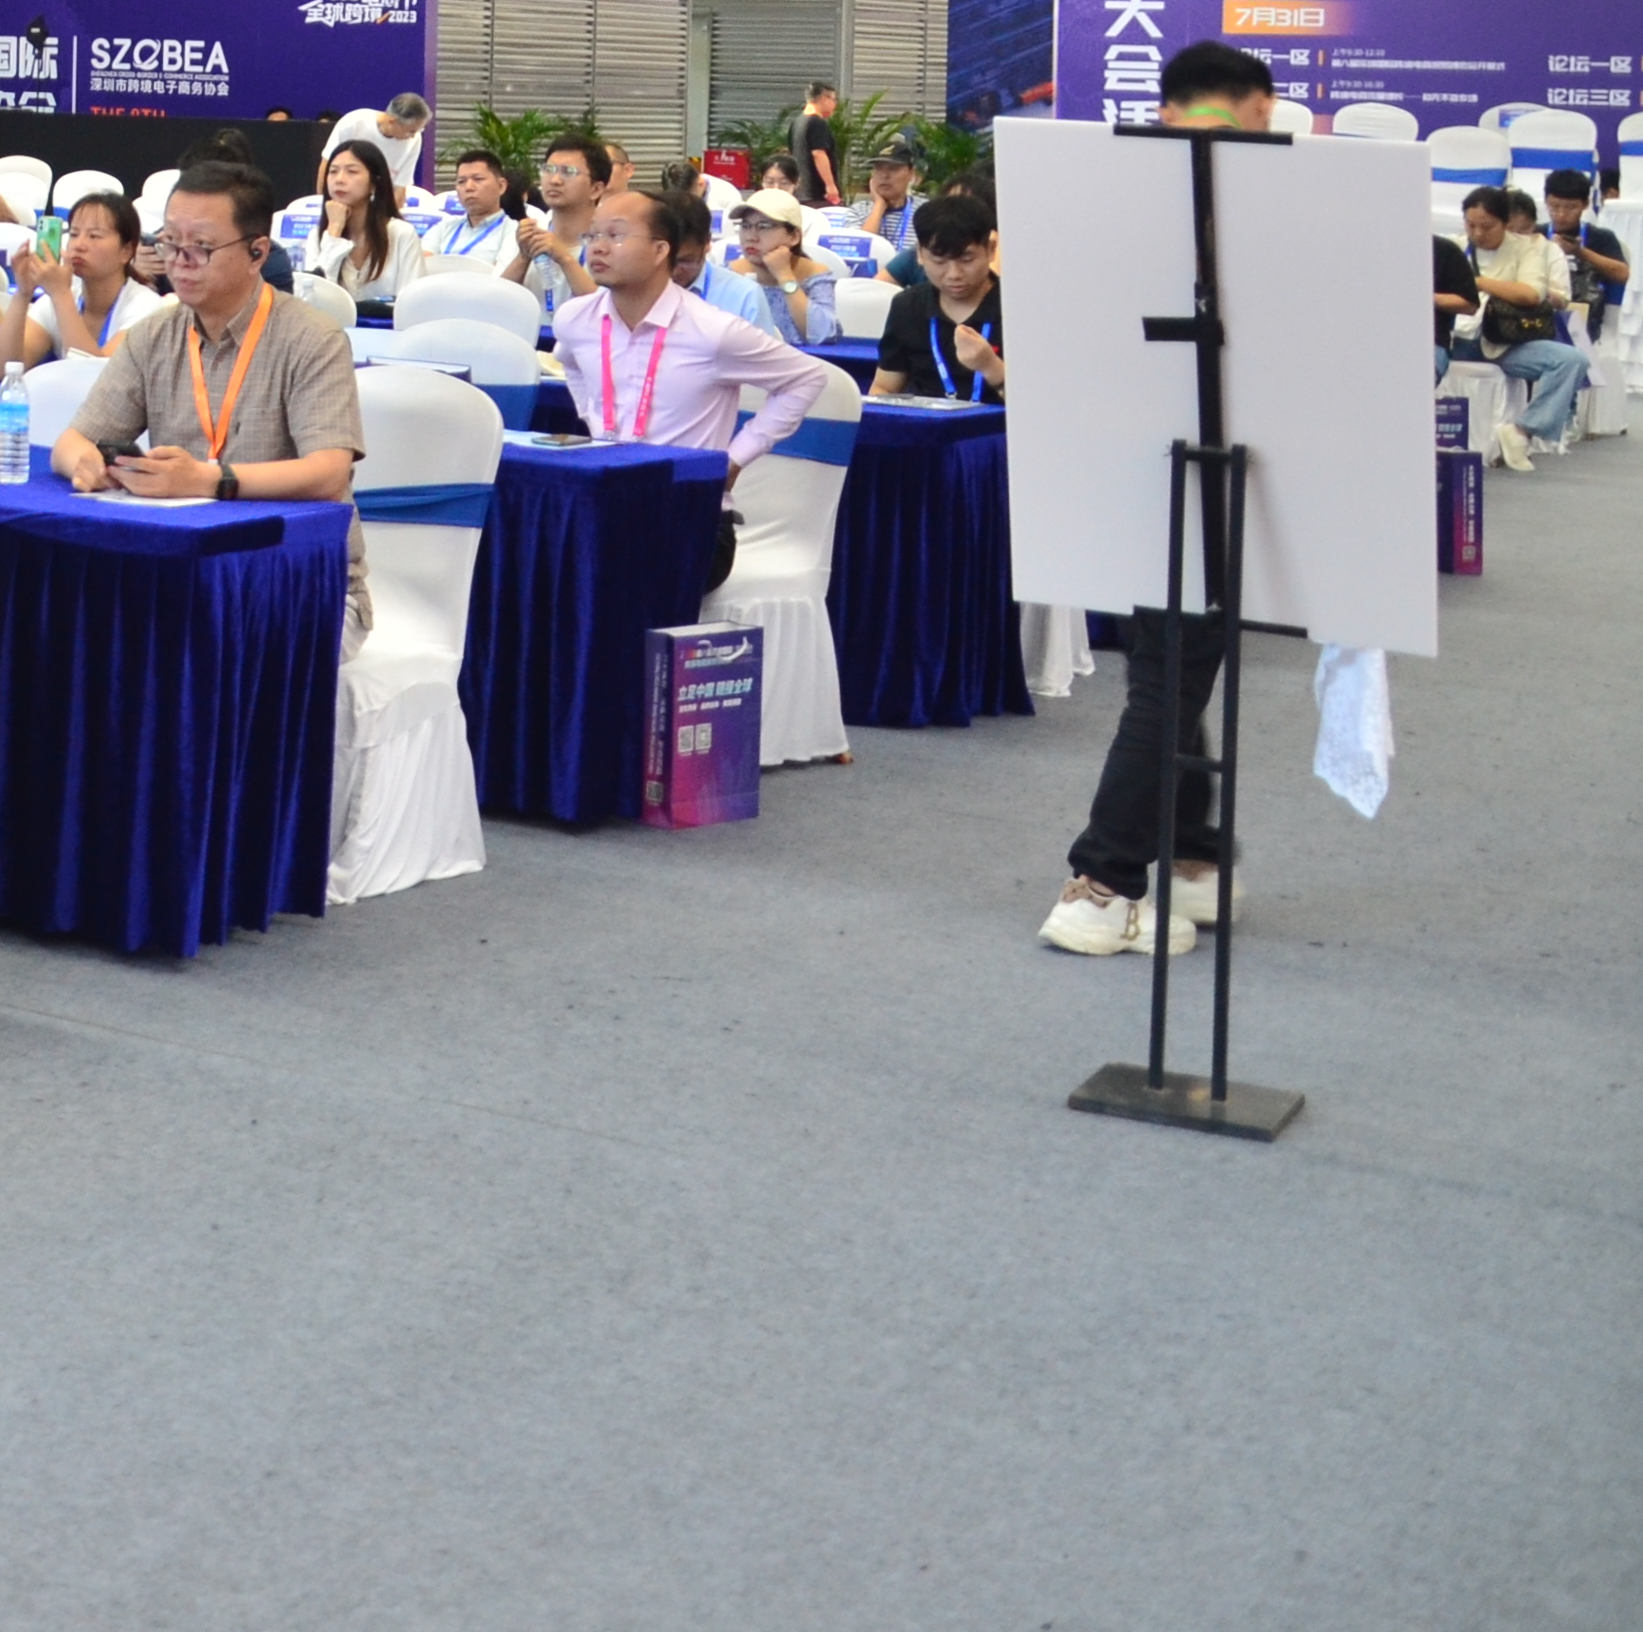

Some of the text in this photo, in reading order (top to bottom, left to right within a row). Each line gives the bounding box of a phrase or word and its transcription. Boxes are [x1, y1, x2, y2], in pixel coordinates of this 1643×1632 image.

[387, 10, 418, 24] 2023
[1234, 7, 1325, 28] 7月31日
[1547, 54, 1633, 74] 论坛一区
[89, 77, 230, 97] 深圳市跨境电子商务协会
[1547, 87, 1632, 107] 论坛三区
